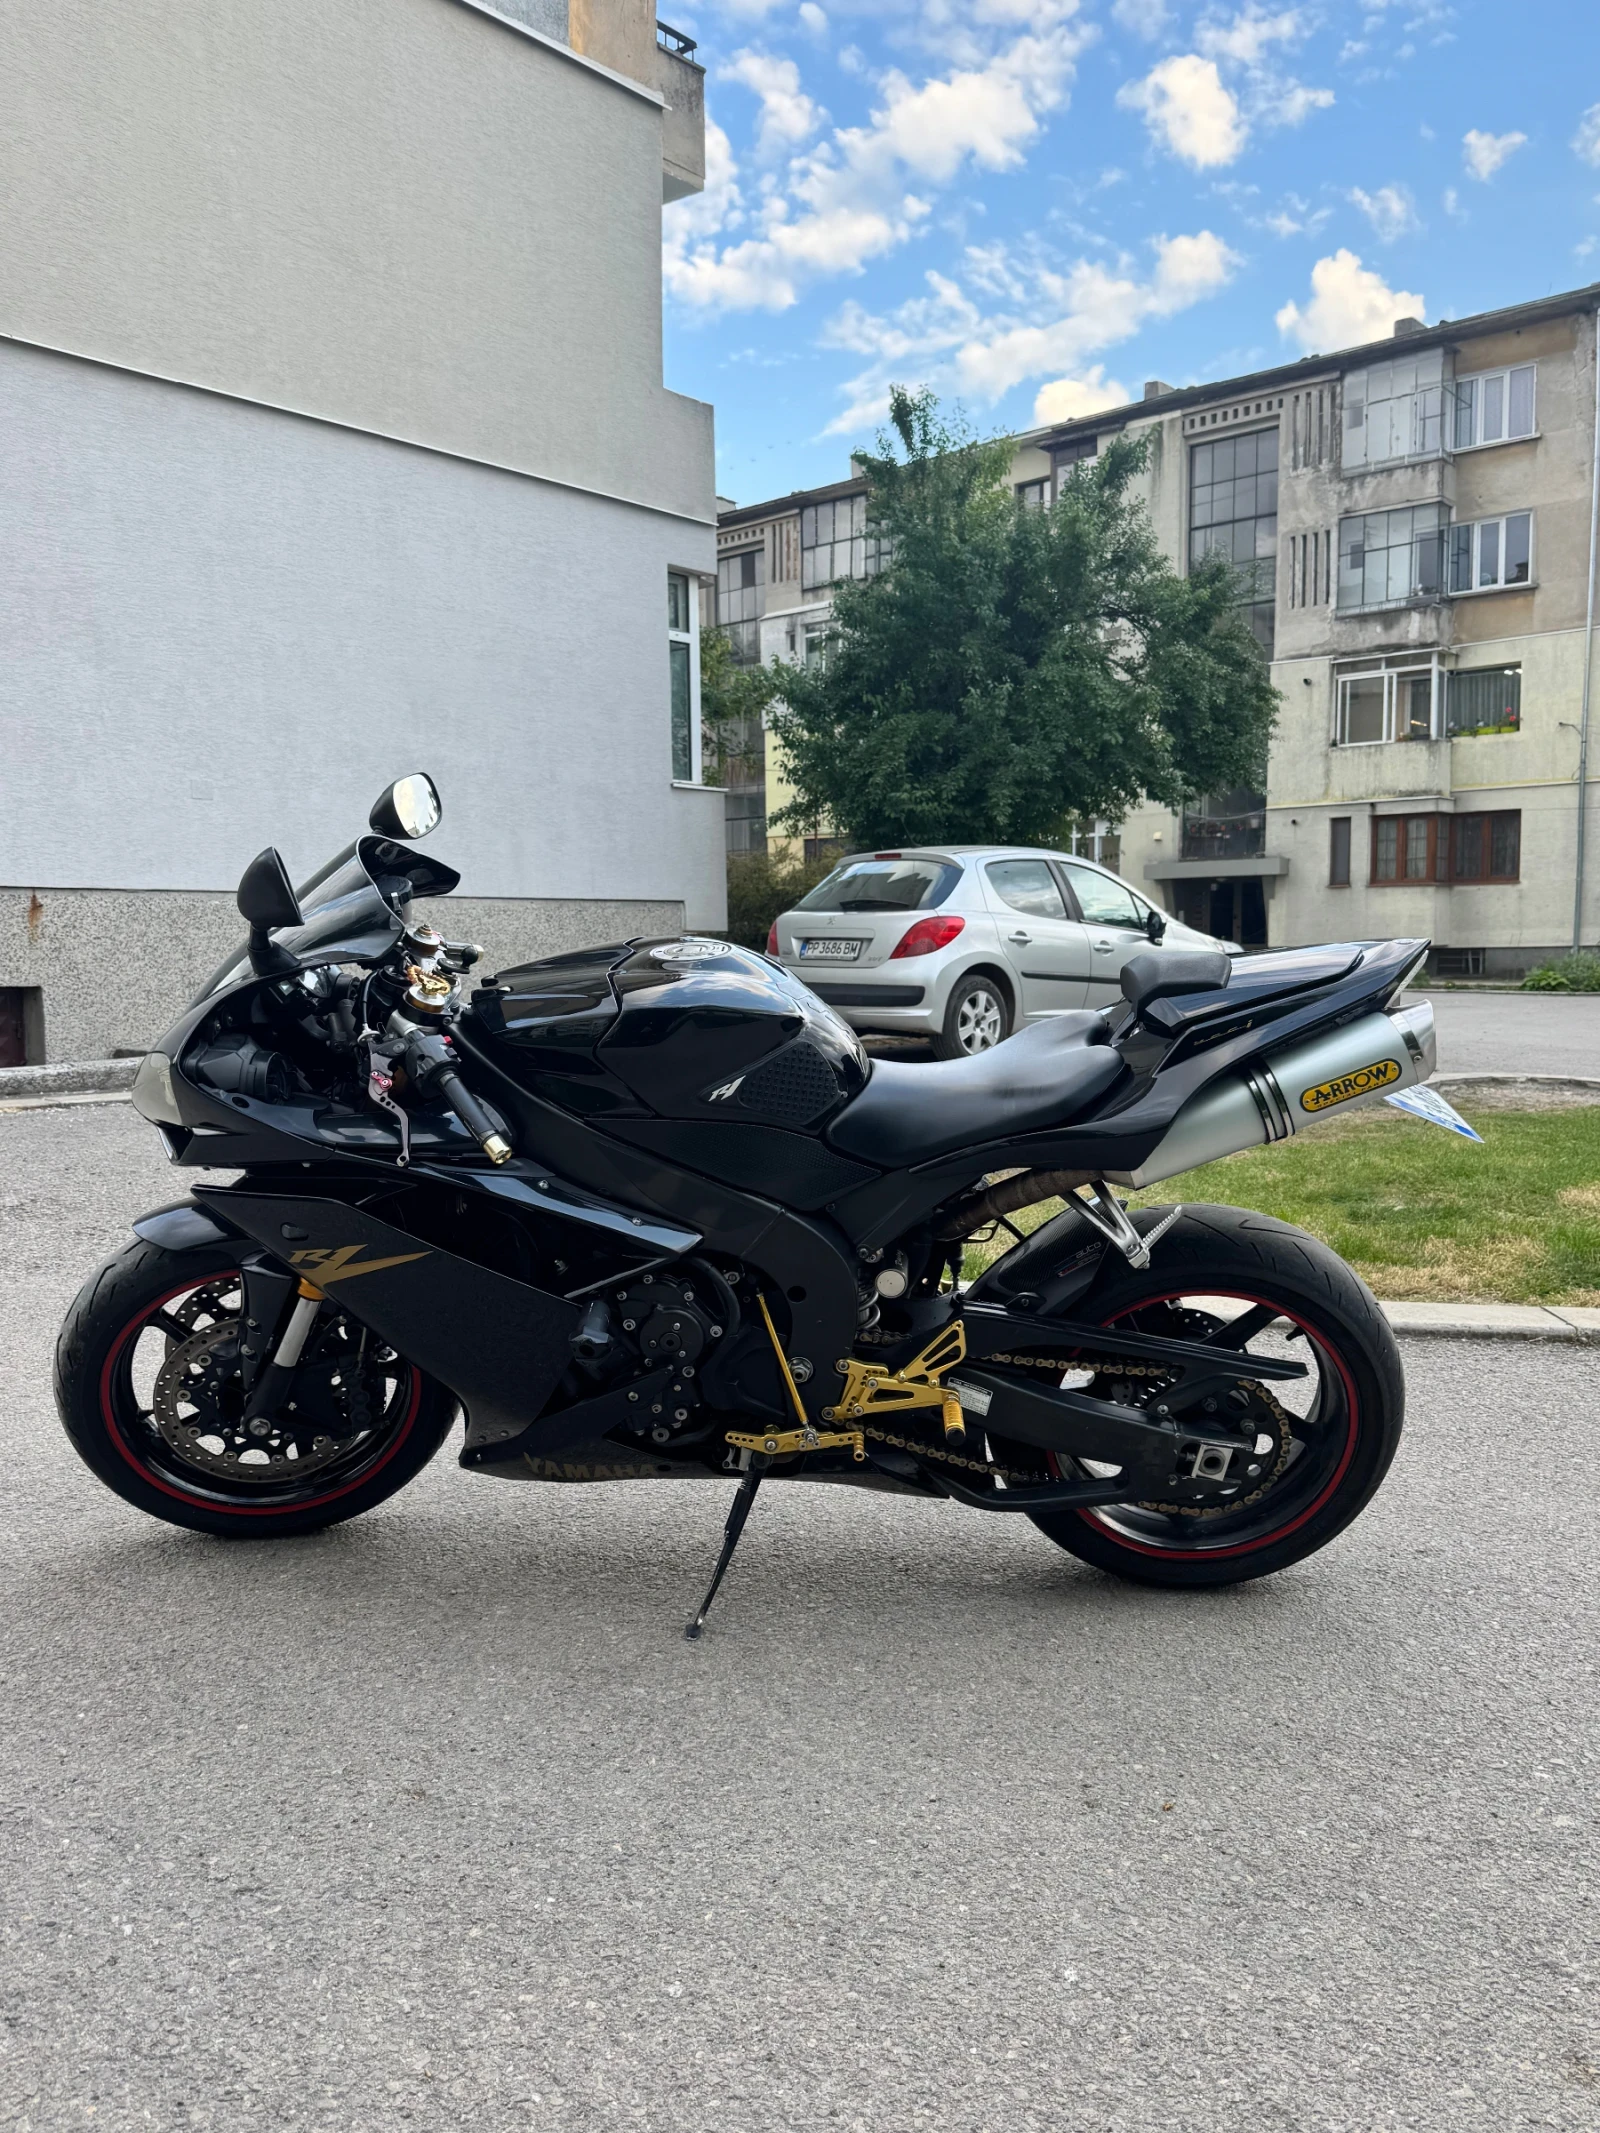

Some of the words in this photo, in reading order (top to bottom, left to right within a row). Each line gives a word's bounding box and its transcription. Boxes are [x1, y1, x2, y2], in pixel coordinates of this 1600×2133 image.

[806, 942, 819, 954] PP
[819, 942, 842, 955] 3686
[843, 942, 859, 955] BM
[1311, 1063, 1389, 1105] ARROW
[523, 1451, 659, 1479] YAMAHA
